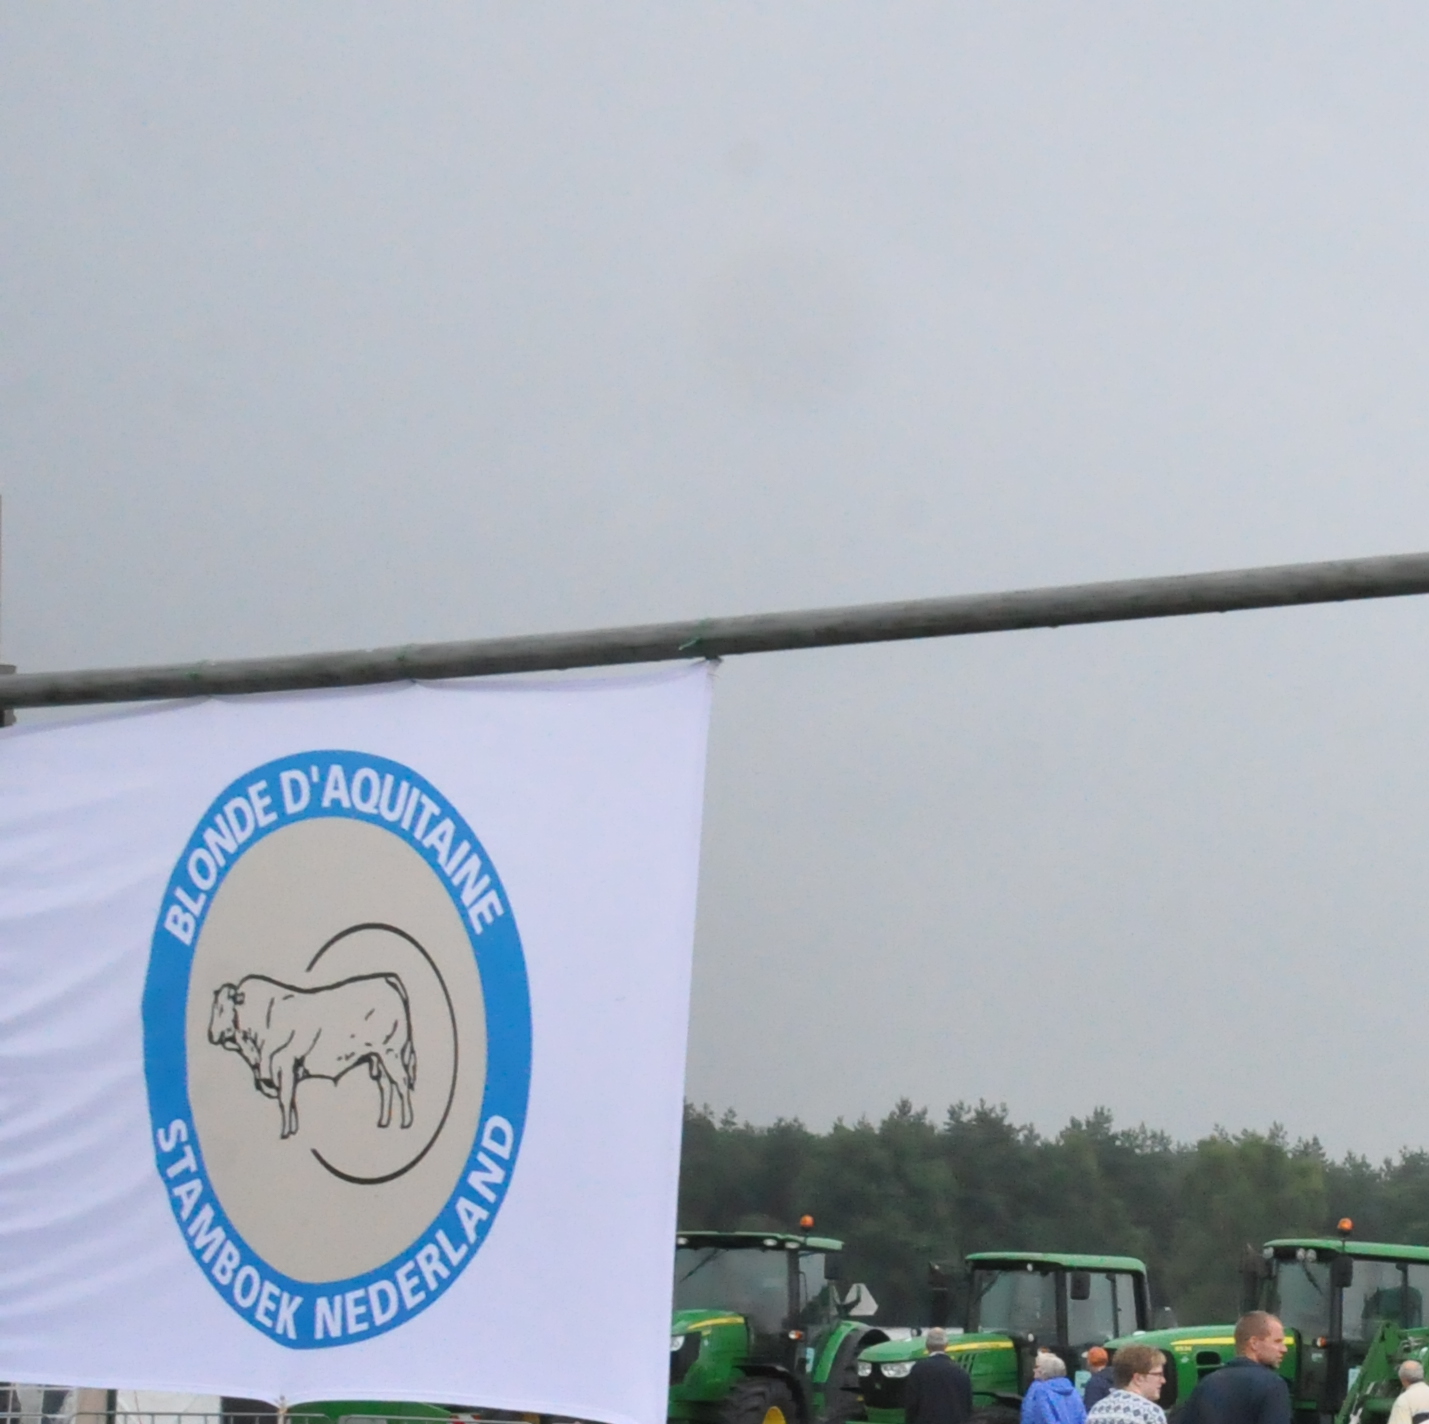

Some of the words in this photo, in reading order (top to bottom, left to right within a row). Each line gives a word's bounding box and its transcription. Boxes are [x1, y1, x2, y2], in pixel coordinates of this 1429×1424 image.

[164, 779, 278, 946] BLONDE
[281, 765, 503, 934] D'AQUITAINE
[157, 1118, 303, 1340] STAMBOEK
[314, 1115, 514, 1339] NEDERLAND
